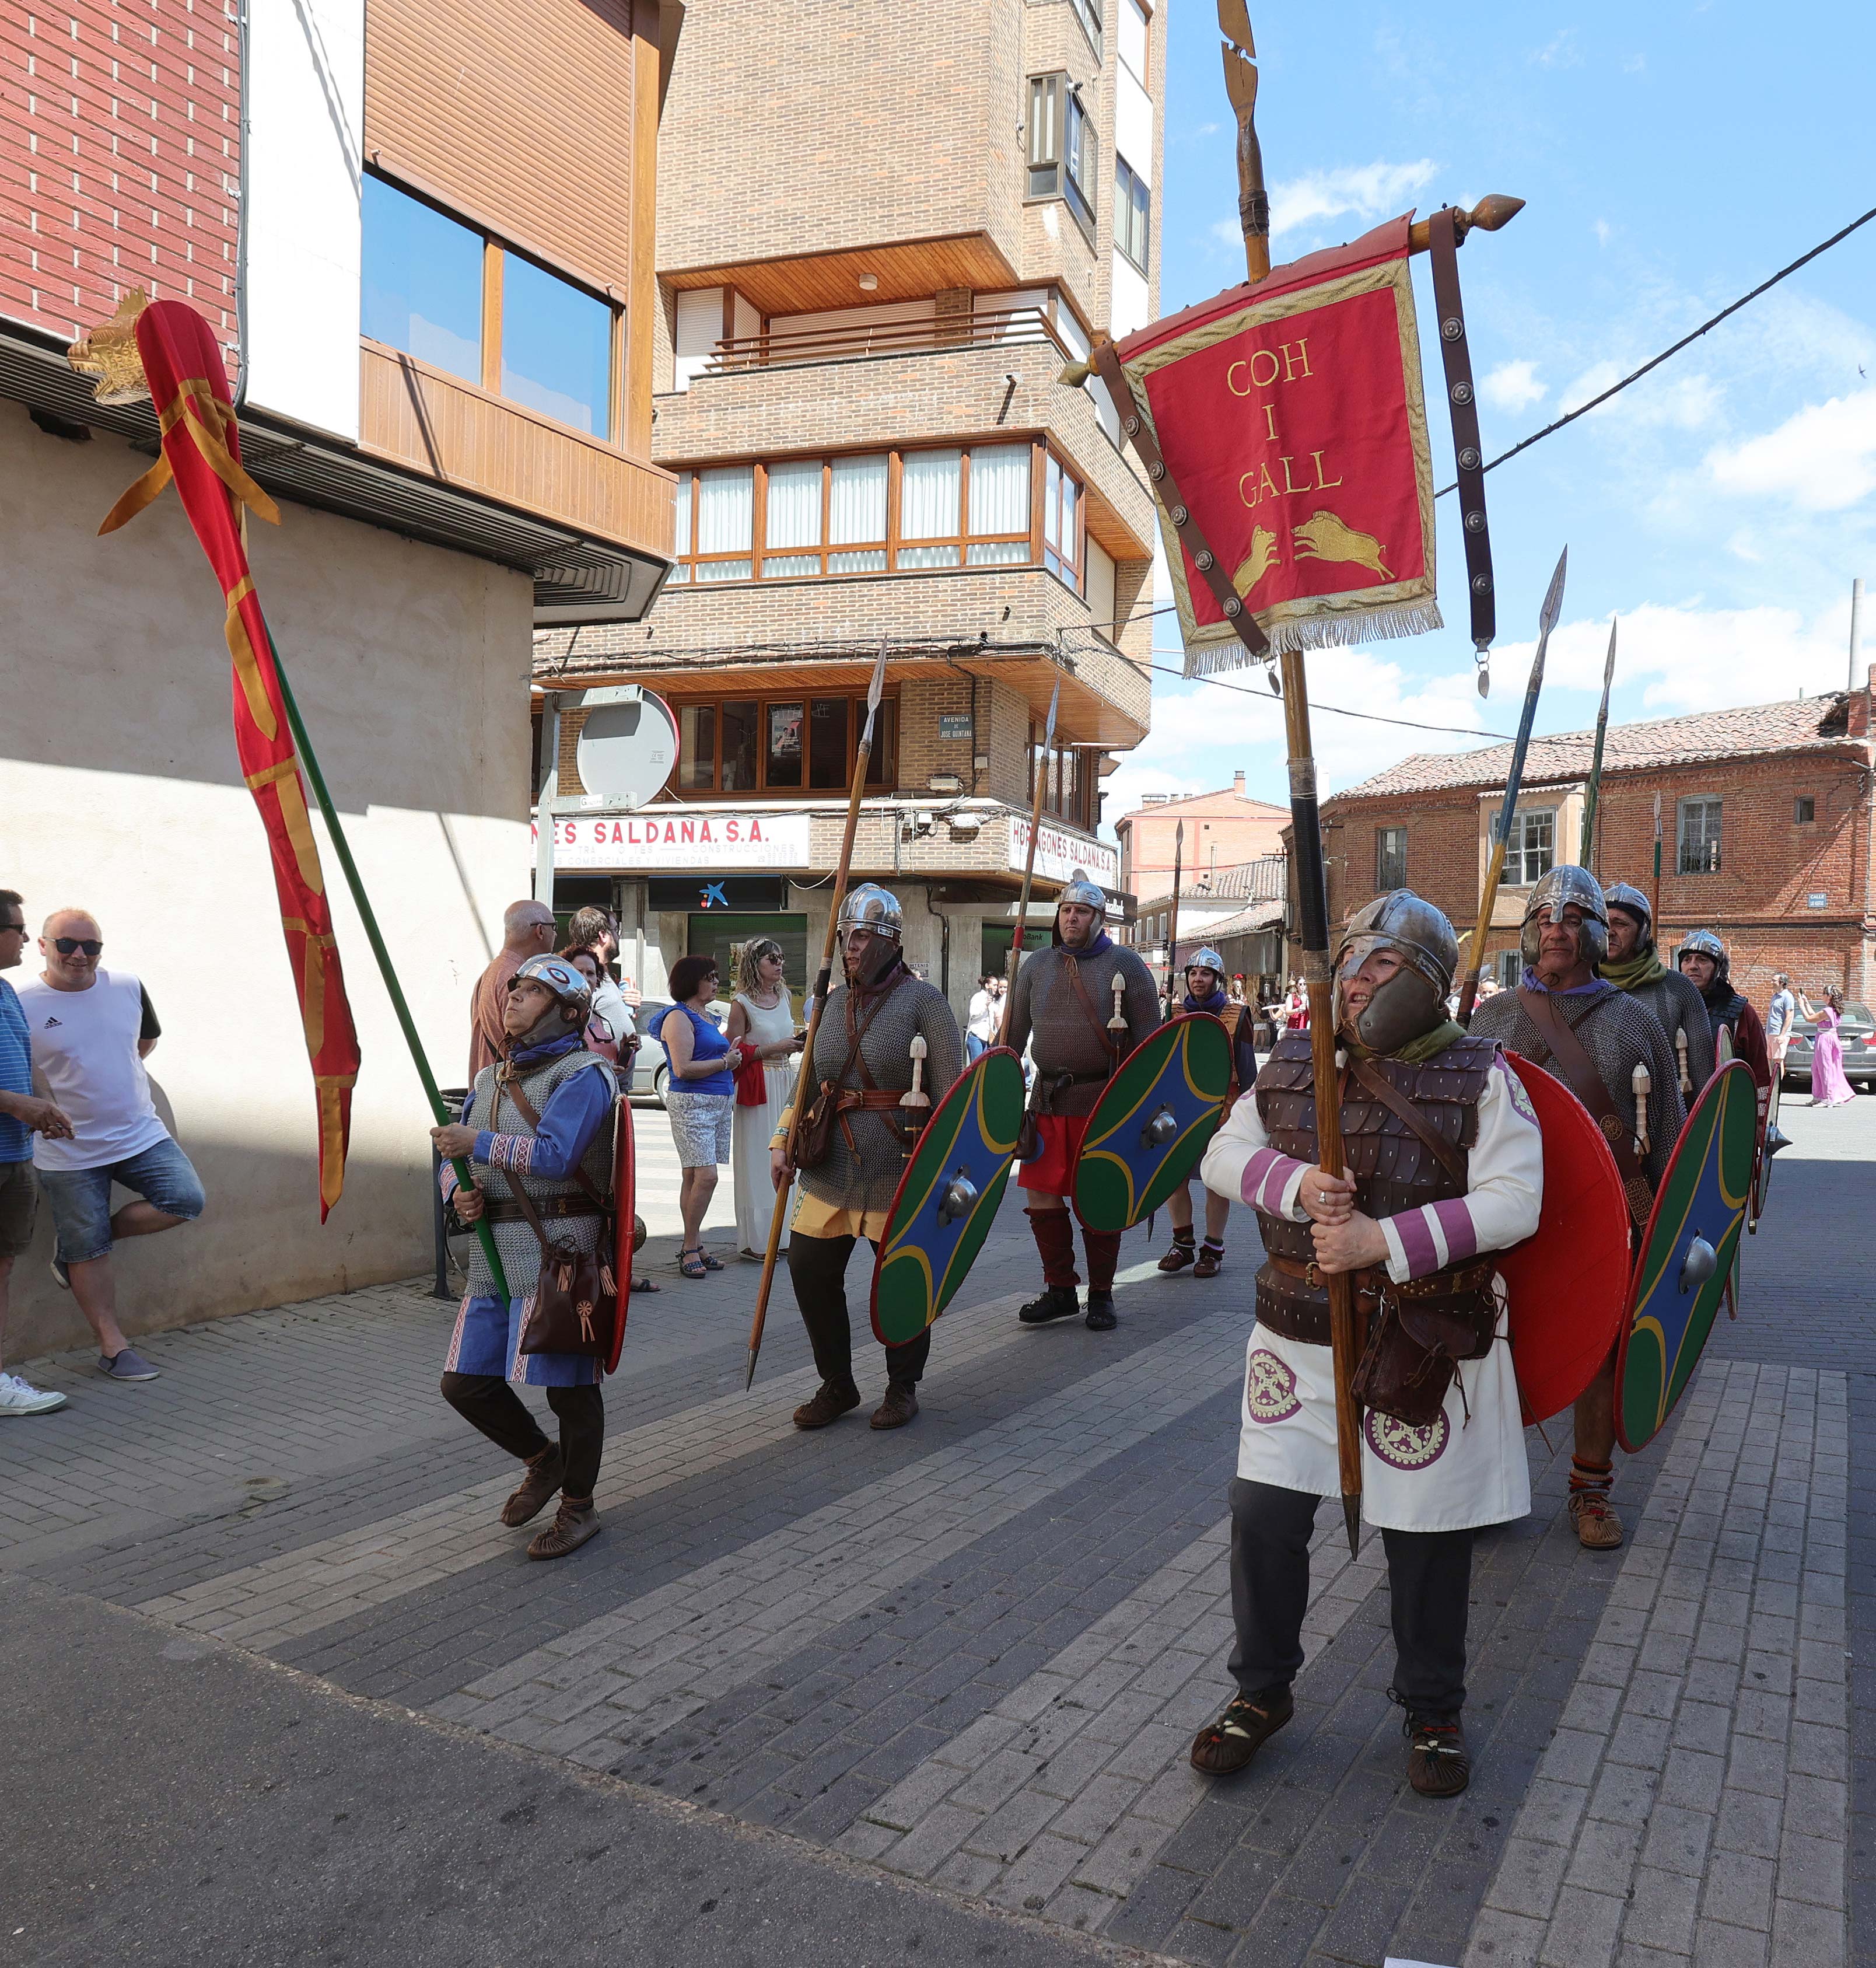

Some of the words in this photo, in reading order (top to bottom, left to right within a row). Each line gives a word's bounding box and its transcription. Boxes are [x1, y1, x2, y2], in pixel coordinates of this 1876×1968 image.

[1227, 338, 1314, 396] COH
[1262, 404, 1279, 441] I
[1239, 450, 1343, 508] GALL
[692, 844, 795, 853] CONSTRUCCIONES
[1013, 820, 1067, 859] HORIGONES
[569, 857, 641, 865] COMERCIALES
[657, 857, 709, 865] VIVIENDAS
